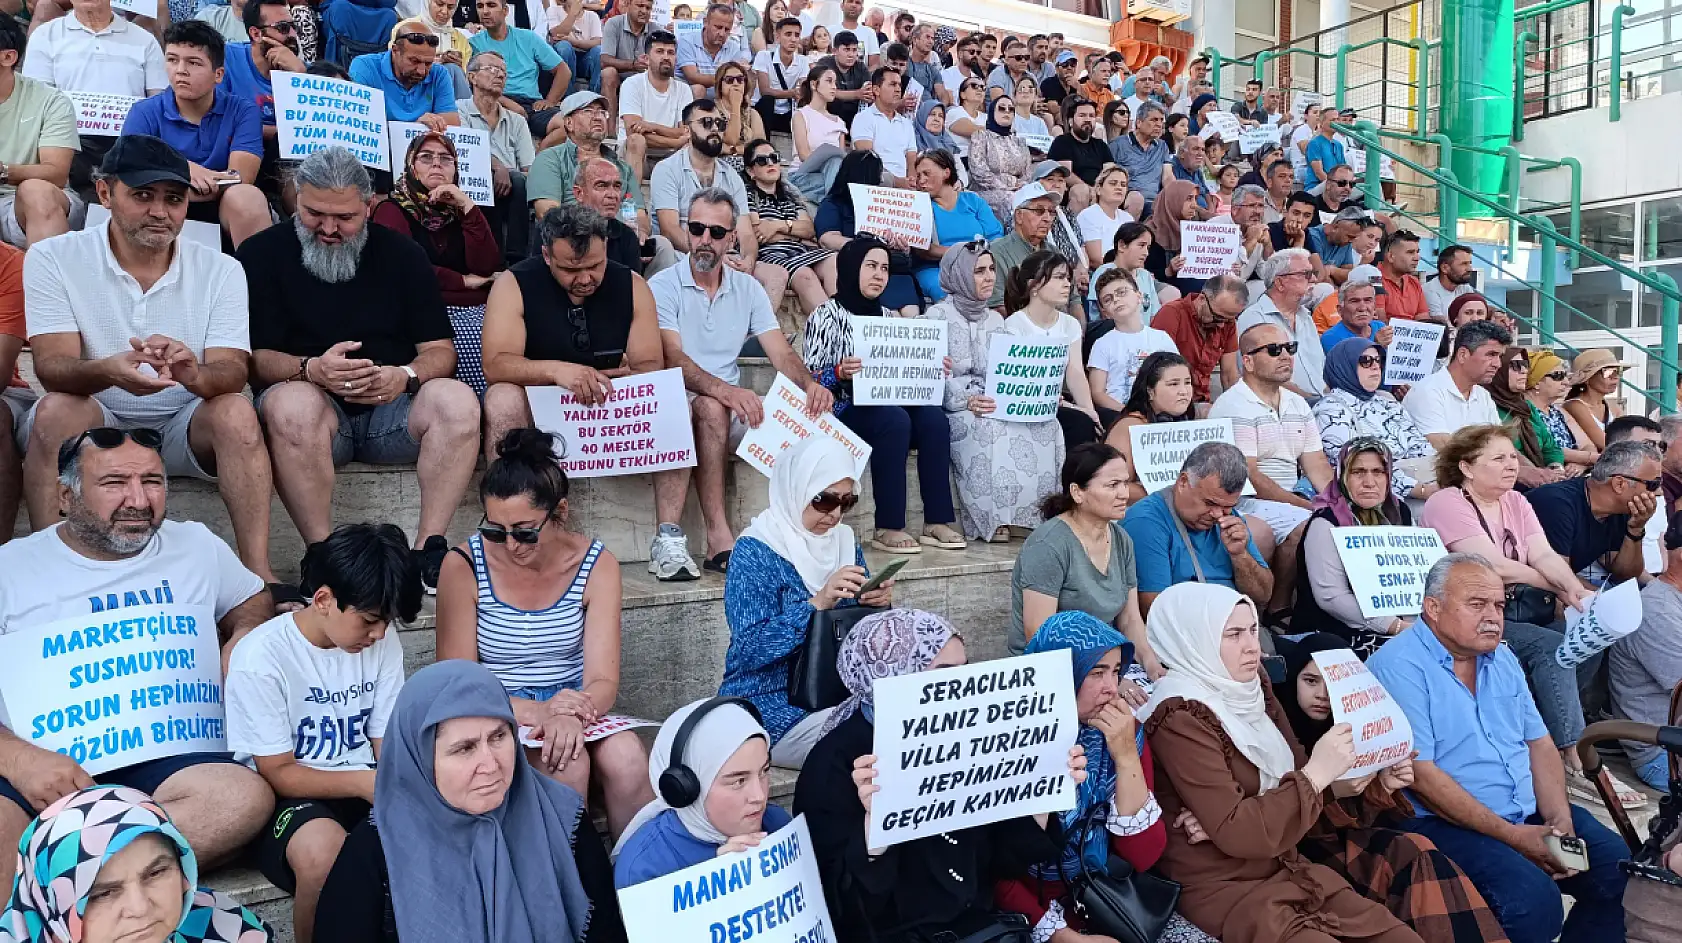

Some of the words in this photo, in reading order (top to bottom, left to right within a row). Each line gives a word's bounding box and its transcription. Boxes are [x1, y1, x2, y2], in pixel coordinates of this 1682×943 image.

[290, 77, 371, 102] BALIKÇILAR
[297, 94, 370, 115] DESTEKTE!
[285, 110, 307, 121] BU
[312, 110, 382, 134] MÜCADELE
[293, 125, 327, 139] TÜM
[332, 129, 379, 148] HALKIN
[291, 141, 382, 165] MÜLESİ!
[863, 322, 910, 341] ÇİFTÇİLER
[912, 326, 941, 341] SESSİZ
[870, 345, 936, 360] KALMAYACAK!
[860, 363, 899, 379] TURİZM
[902, 364, 943, 380] HEPİMİZE
[995, 363, 1047, 378] SUSKUN
[560, 383, 656, 405] NAYECİLER
[871, 386, 891, 399] CAN
[895, 384, 935, 400] VERİYOR!
[996, 381, 1042, 397] BUGÜN
[564, 409, 609, 422] YALNIZ
[614, 401, 658, 419] DEĞİL!
[578, 427, 596, 438] BU
[600, 420, 651, 437] SEKTÖR
[1141, 428, 1190, 449] ÇİFTÇİLER
[1193, 424, 1225, 441] SESSİZ
[581, 443, 598, 455] 40
[602, 438, 656, 453] MESLEK
[619, 449, 690, 468] ETKİLİYOR!
[1345, 533, 1385, 549] ZEYTİN
[1388, 532, 1438, 548] ÜRETİCİSİ
[1375, 550, 1412, 567] DİYOR
[1378, 573, 1416, 587] ESNAF
[1371, 591, 1413, 609] BİRLİK
[42, 611, 198, 659] MARKETÇİLER
[69, 648, 195, 690] SUSMUYOR!
[919, 667, 1036, 705] SERACILAR
[32, 693, 120, 740] SORUN
[901, 707, 979, 740] YALNIZ
[986, 691, 1055, 725] DEĞİL!
[151, 712, 224, 744] BİRLİKTE!
[901, 743, 961, 771] VİLLA
[970, 718, 1060, 758] TURİZMİ
[918, 754, 1039, 796] HEPİMİZİN
[882, 799, 956, 830] GEÇİM
[962, 775, 1065, 816] KAYNAĞI!
[673, 857, 751, 914] MANAV
[709, 881, 806, 943] DESTEKTE!
